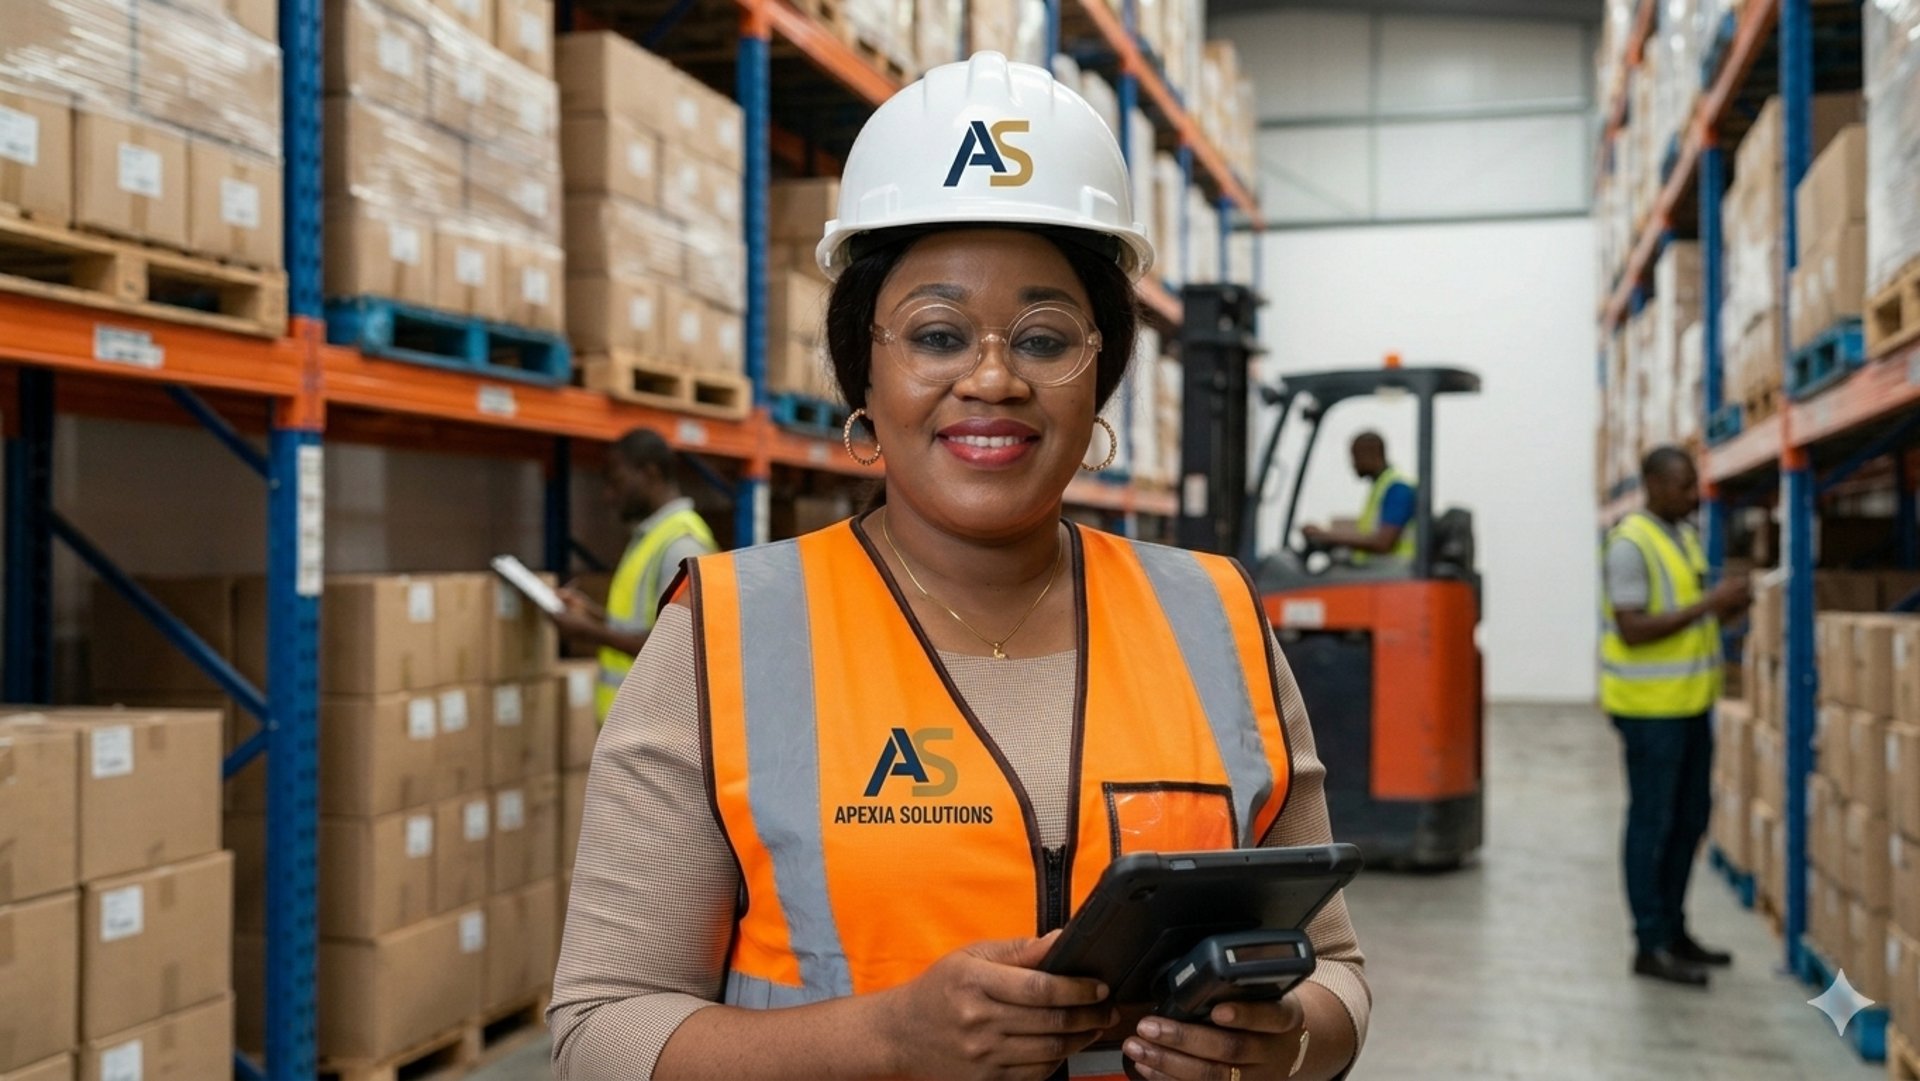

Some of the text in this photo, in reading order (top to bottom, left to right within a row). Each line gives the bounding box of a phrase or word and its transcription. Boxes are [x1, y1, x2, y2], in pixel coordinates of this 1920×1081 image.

[943, 120, 1034, 188] AS
[863, 727, 959, 797] AS
[834, 805, 994, 825] APEXIA SOLUTIONS
